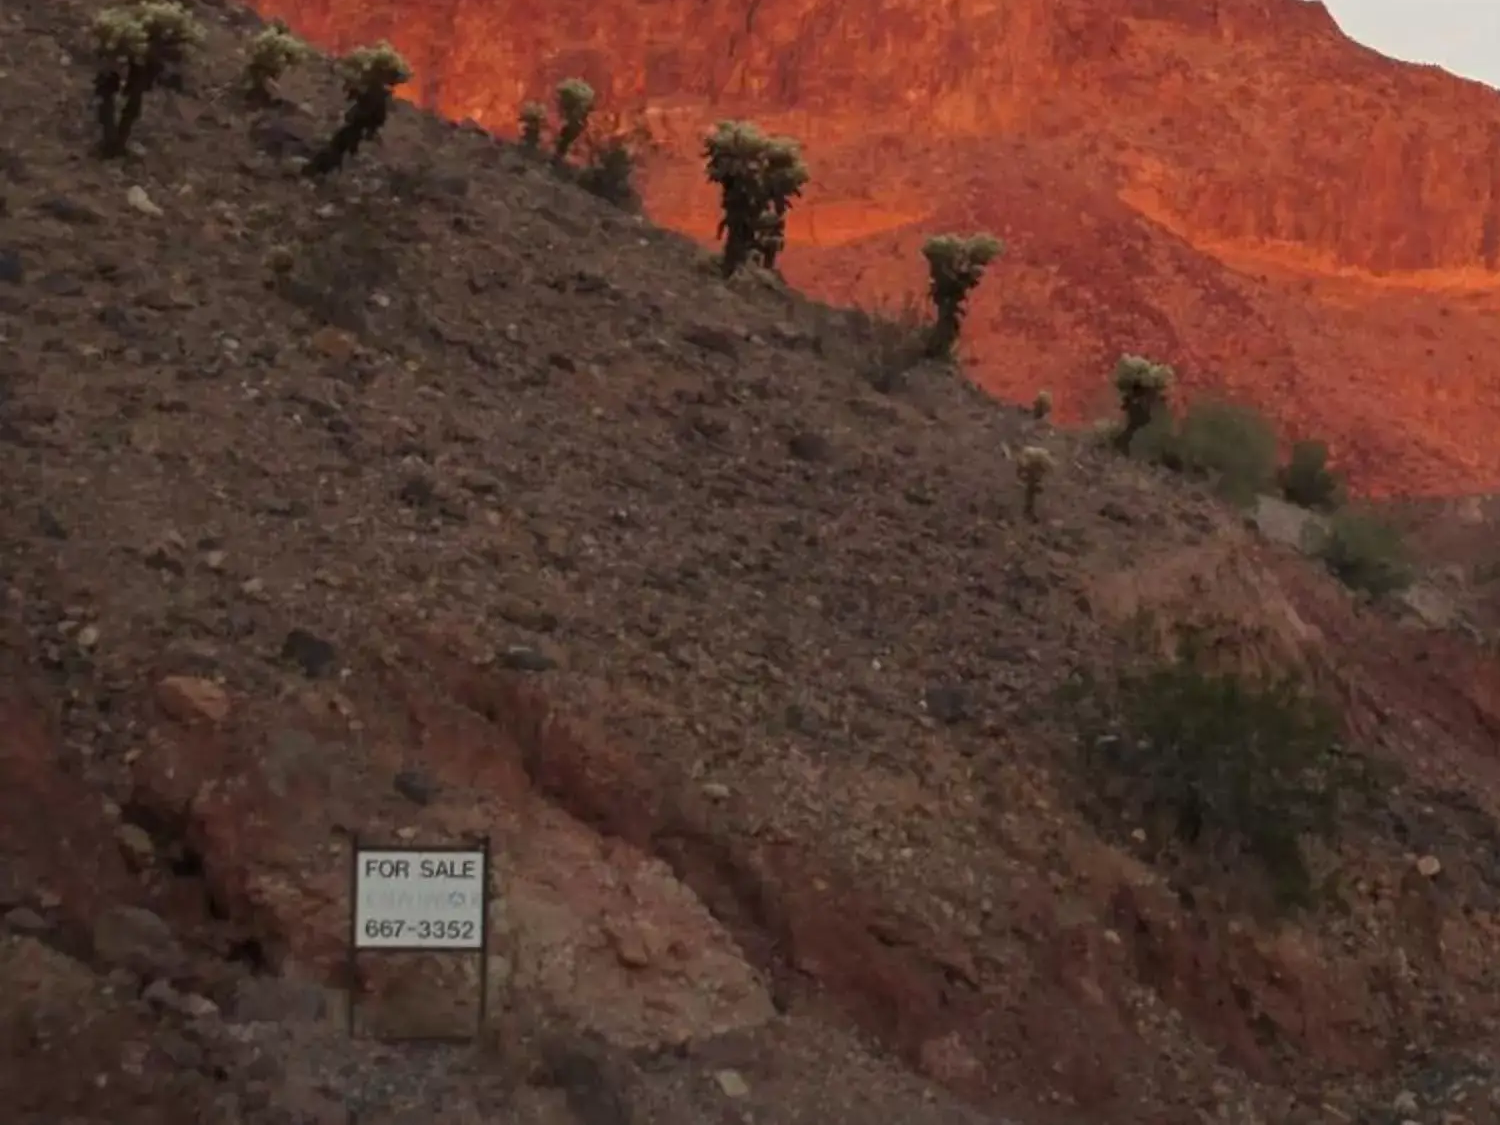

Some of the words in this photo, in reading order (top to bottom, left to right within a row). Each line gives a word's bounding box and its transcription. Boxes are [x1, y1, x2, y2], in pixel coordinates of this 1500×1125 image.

[365, 860, 410, 878] FOR
[420, 860, 475, 878] SALE
[365, 920, 474, 939] 667-3352
